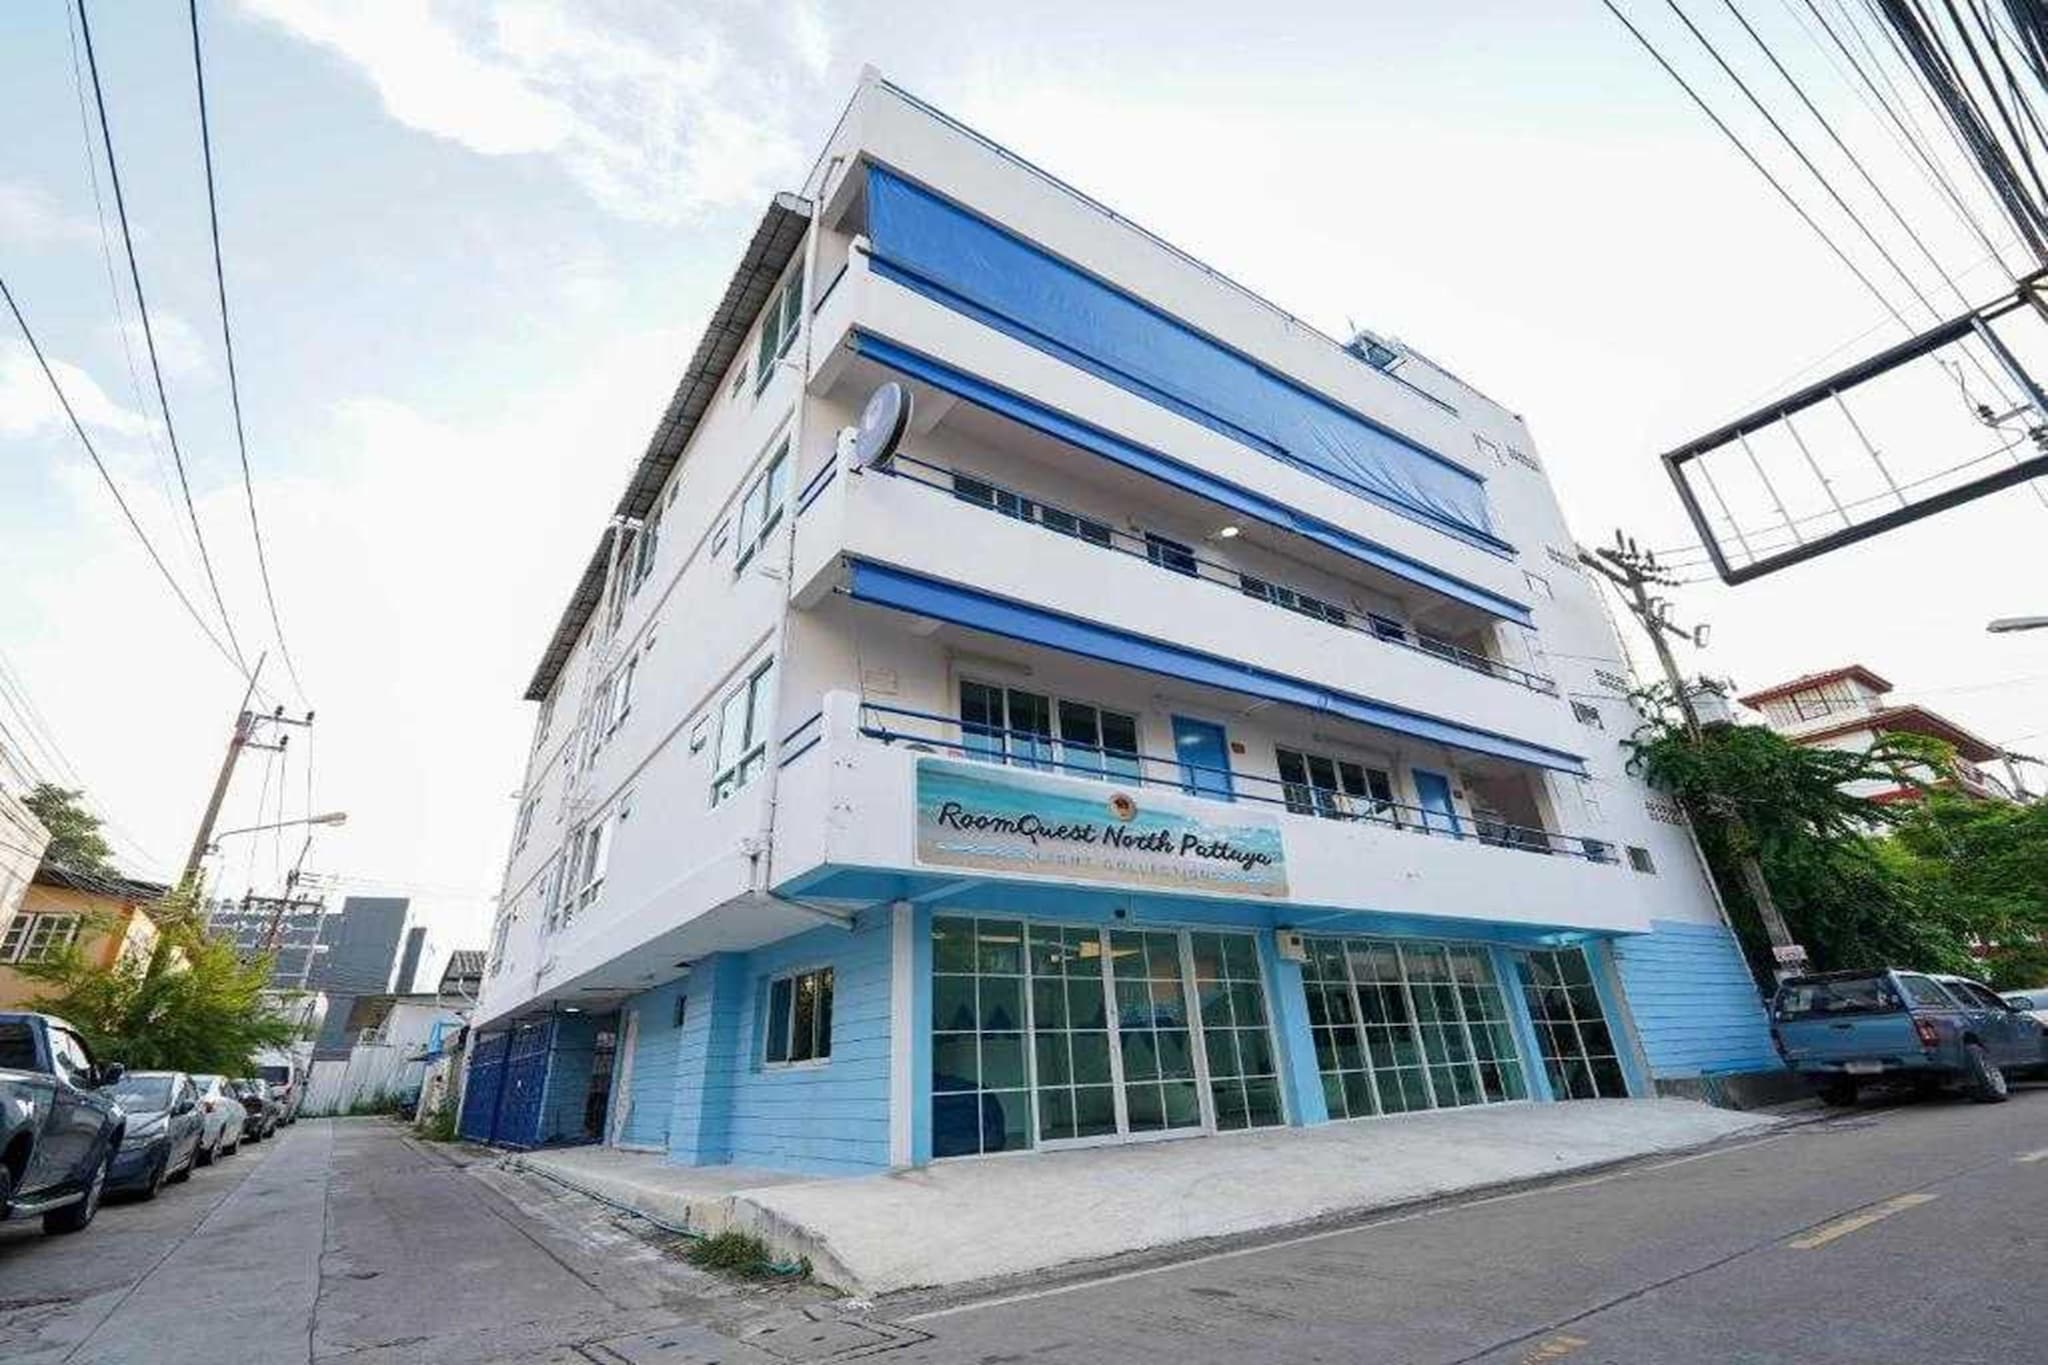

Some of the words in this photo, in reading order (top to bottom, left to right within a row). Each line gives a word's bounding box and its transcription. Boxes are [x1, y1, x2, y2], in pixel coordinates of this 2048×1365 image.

[938, 801, 1096, 845] RoomQuest
[1102, 824, 1174, 854] North
[1180, 833, 1272, 871] Pattaya
